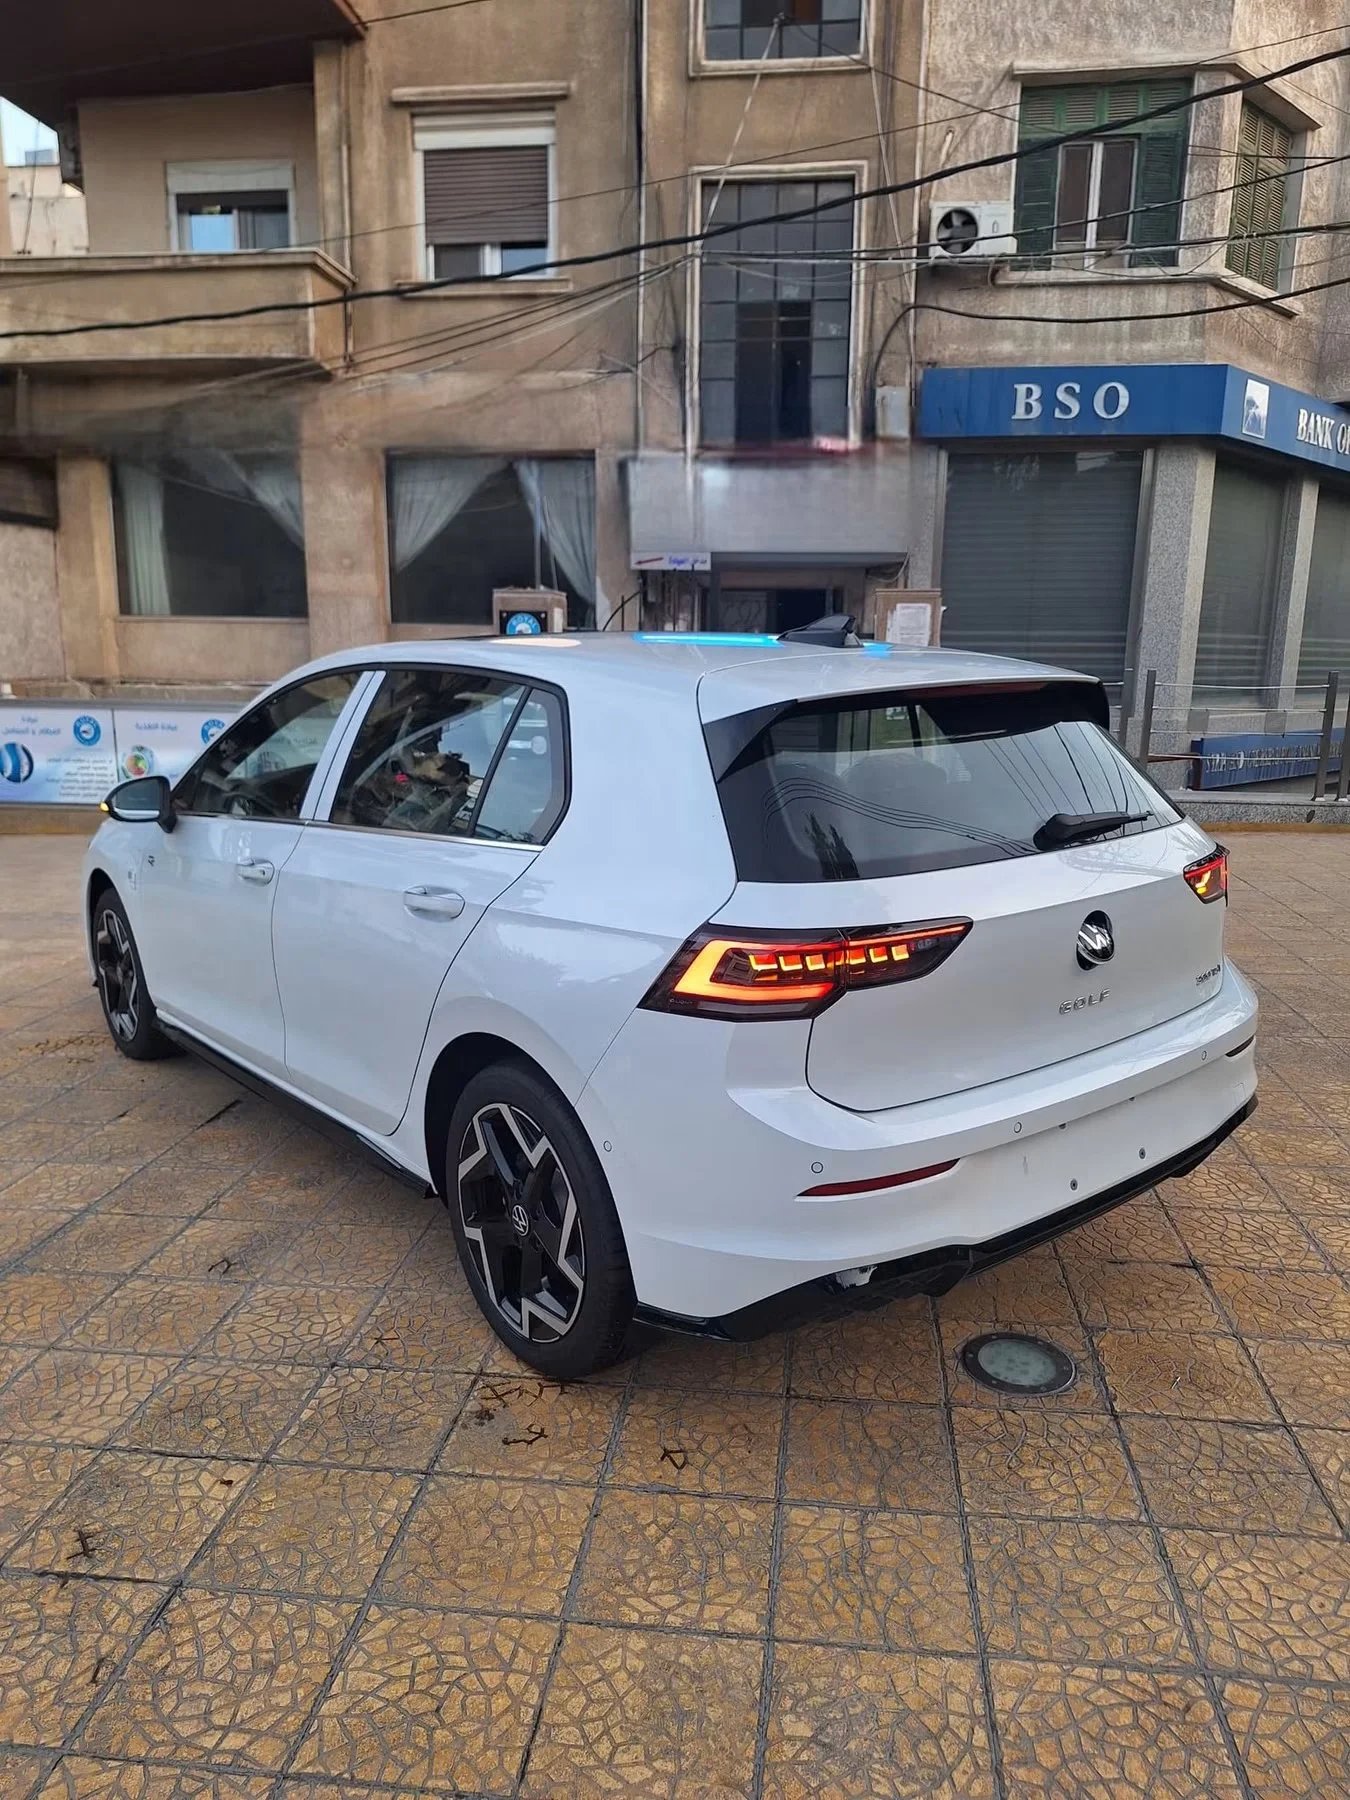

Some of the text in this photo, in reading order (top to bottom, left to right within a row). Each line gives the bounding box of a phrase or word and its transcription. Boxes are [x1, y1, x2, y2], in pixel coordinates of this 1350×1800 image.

[1011, 381, 1131, 420] BSO
[1296, 408, 1335, 450] BANK
[1059, 988, 1110, 1015] GOLF
